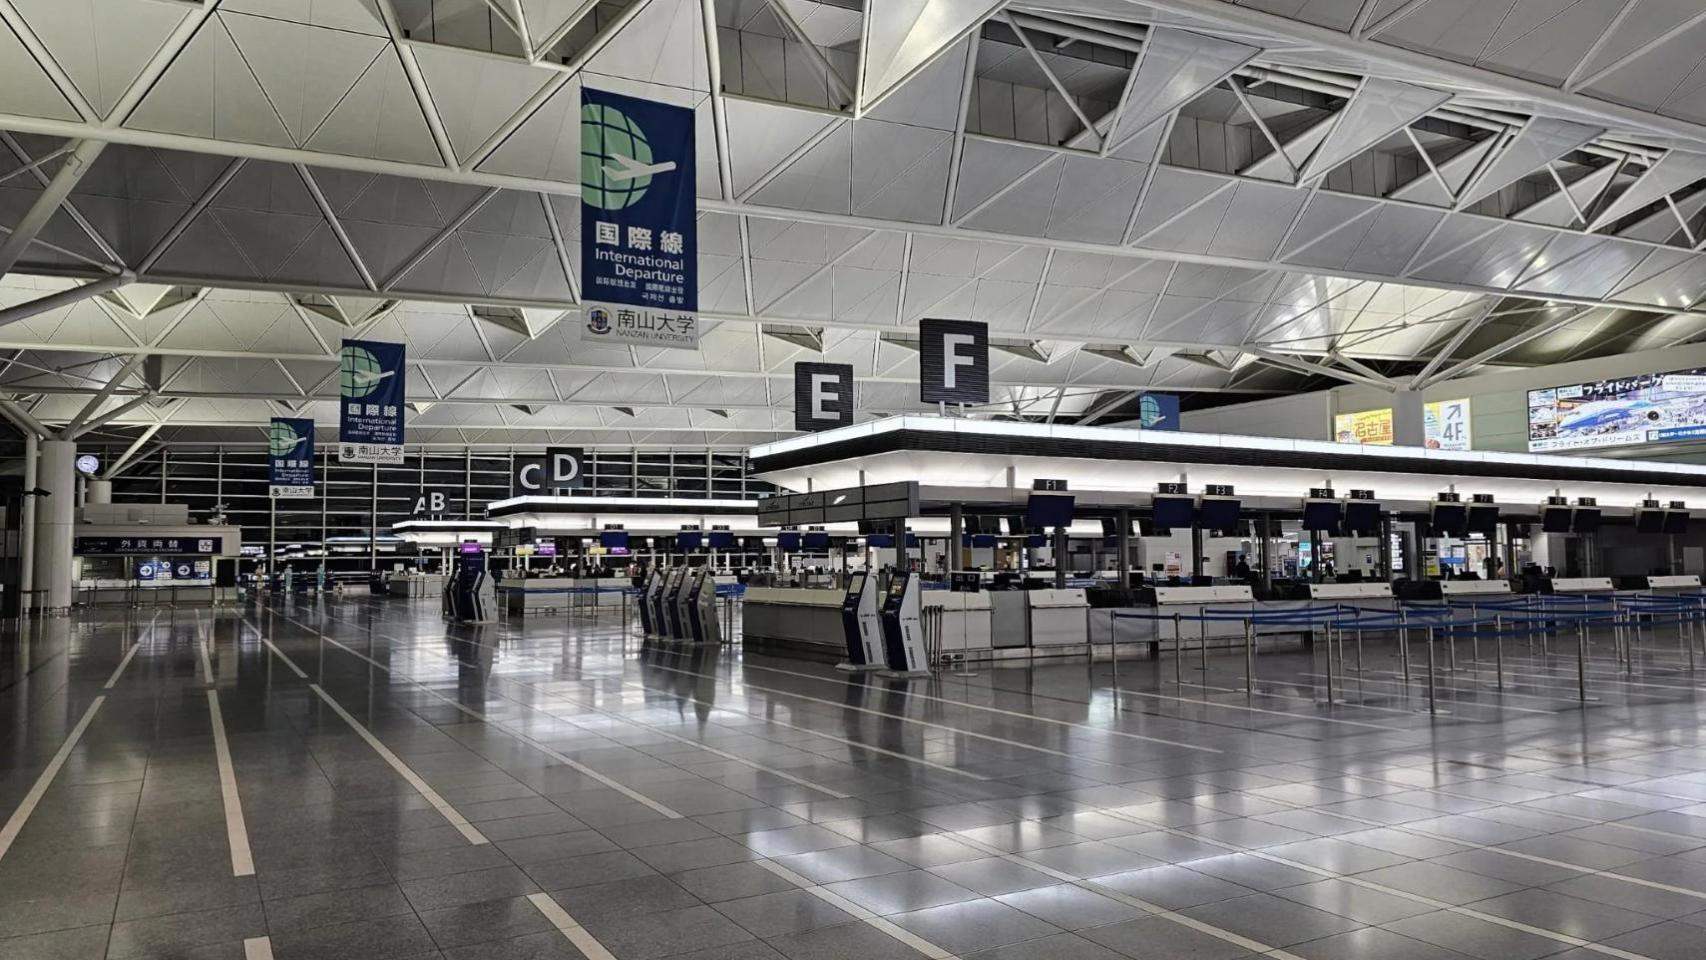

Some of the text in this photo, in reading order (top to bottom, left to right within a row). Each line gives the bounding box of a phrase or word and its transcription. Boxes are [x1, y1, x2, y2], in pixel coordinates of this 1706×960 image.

[596, 221, 683, 254] 国際線
[595, 248, 684, 271] International
[615, 263, 684, 284] Departure
[616, 309, 695, 334] 南山大学
[943, 333, 975, 389] F
[811, 373, 841, 420] E
[347, 416, 397, 426] International
[357, 423, 397, 432] Departure
[1443, 422, 1463, 441] 4F
[358, 445, 402, 457] 南山大学
[520, 463, 540, 490] C
[554, 454, 579, 481] D
[1045, 480, 1057, 490] F1
[1168, 484, 1178, 494] F2
[1216, 485, 1226, 495] F3
[413, 496, 425, 515] A
[430, 492, 446, 511] B
